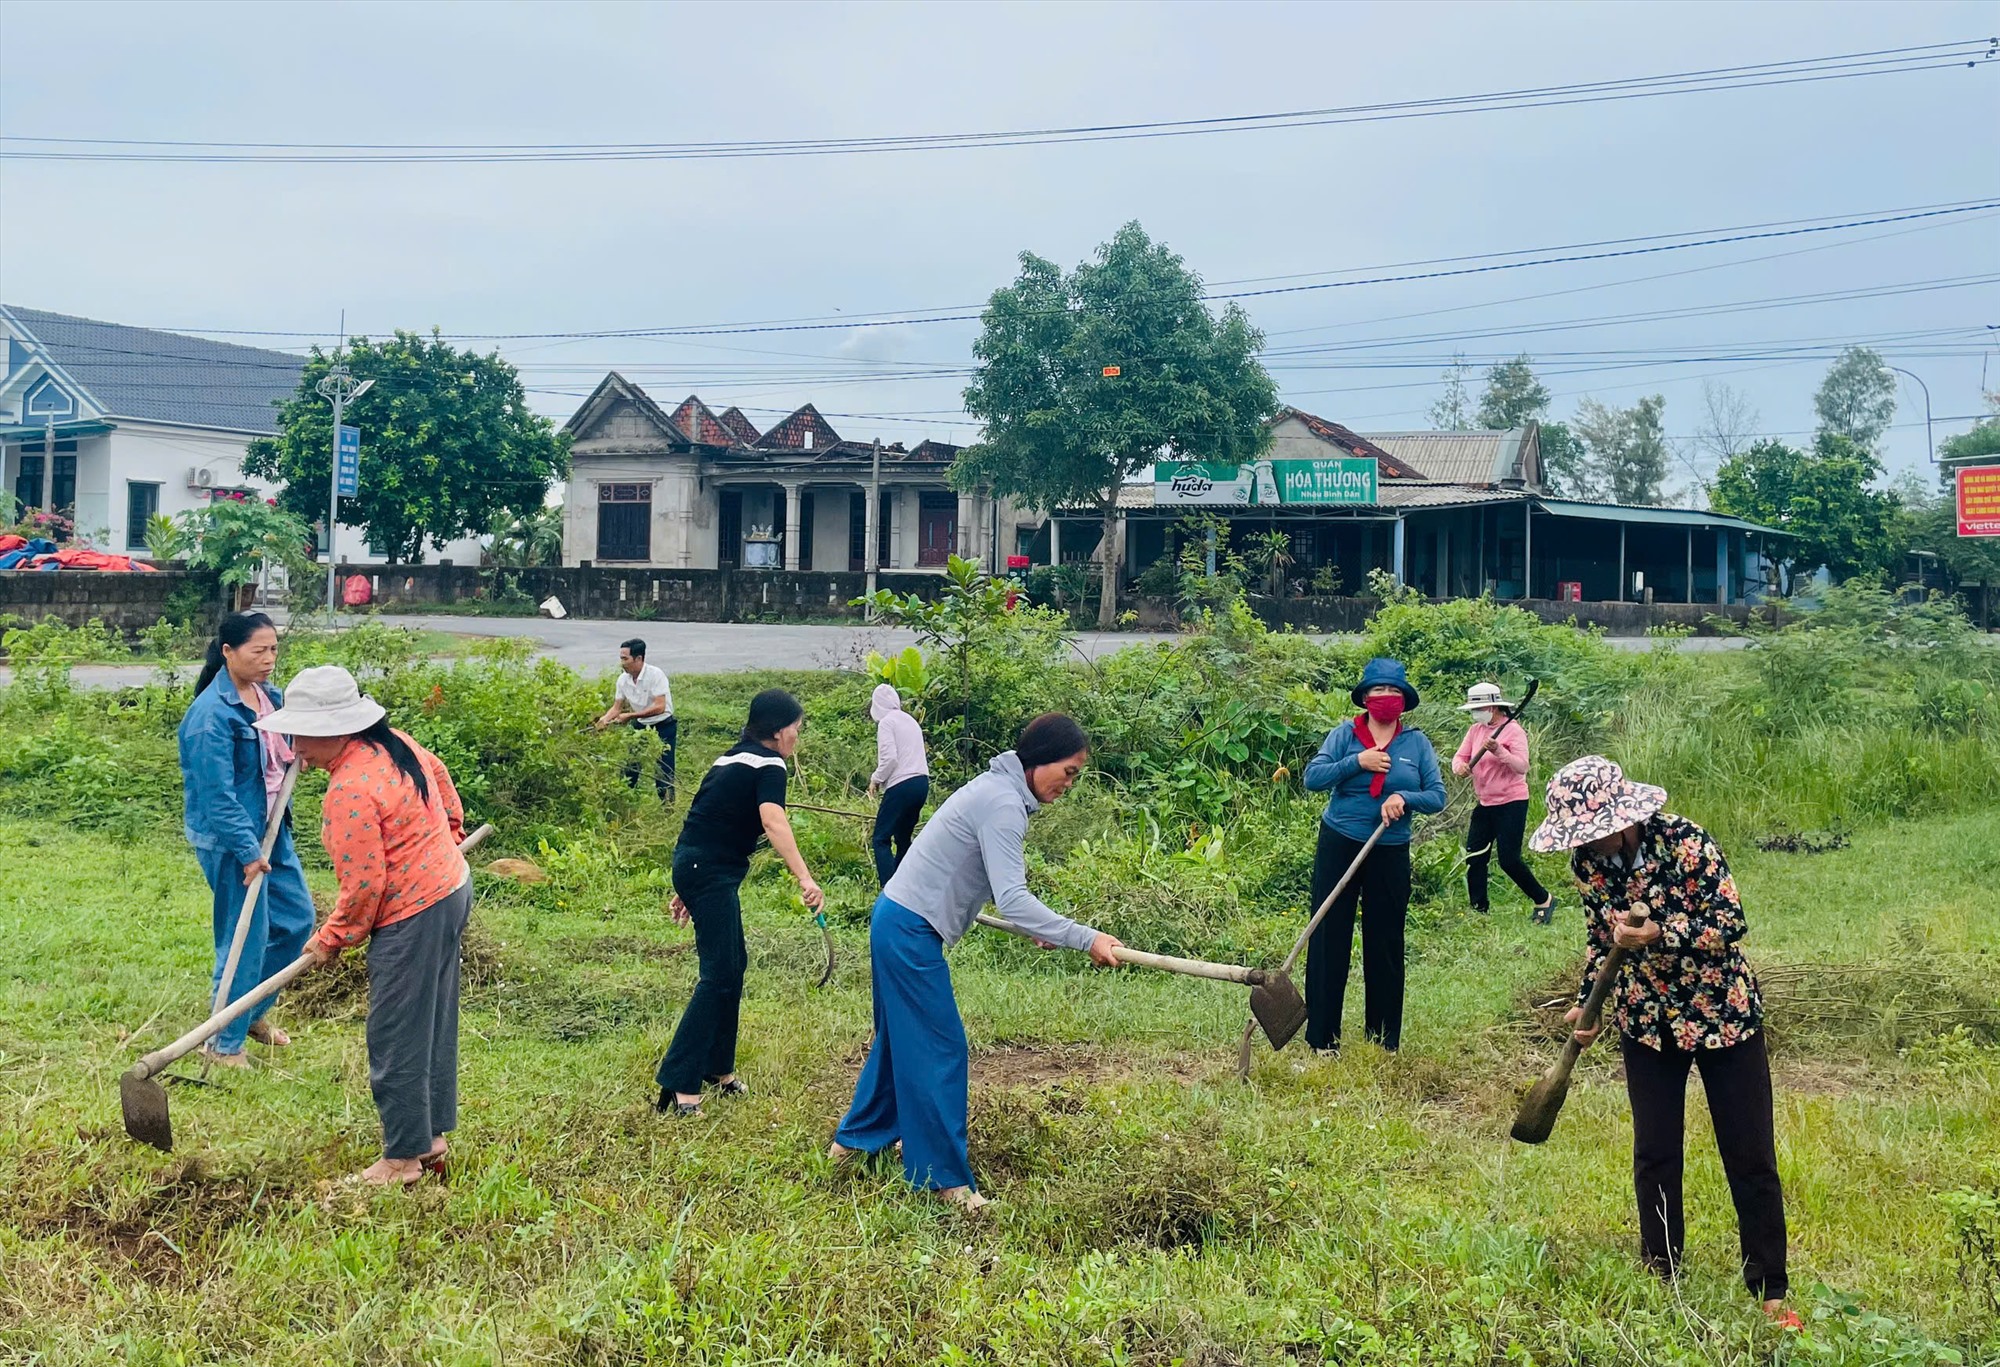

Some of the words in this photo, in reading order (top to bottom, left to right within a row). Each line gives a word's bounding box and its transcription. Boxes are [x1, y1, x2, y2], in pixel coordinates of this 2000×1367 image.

[1171, 476, 1213, 492] huda
[1285, 470, 1312, 488] HÓA
[1314, 470, 1371, 488] THƯƠNG
